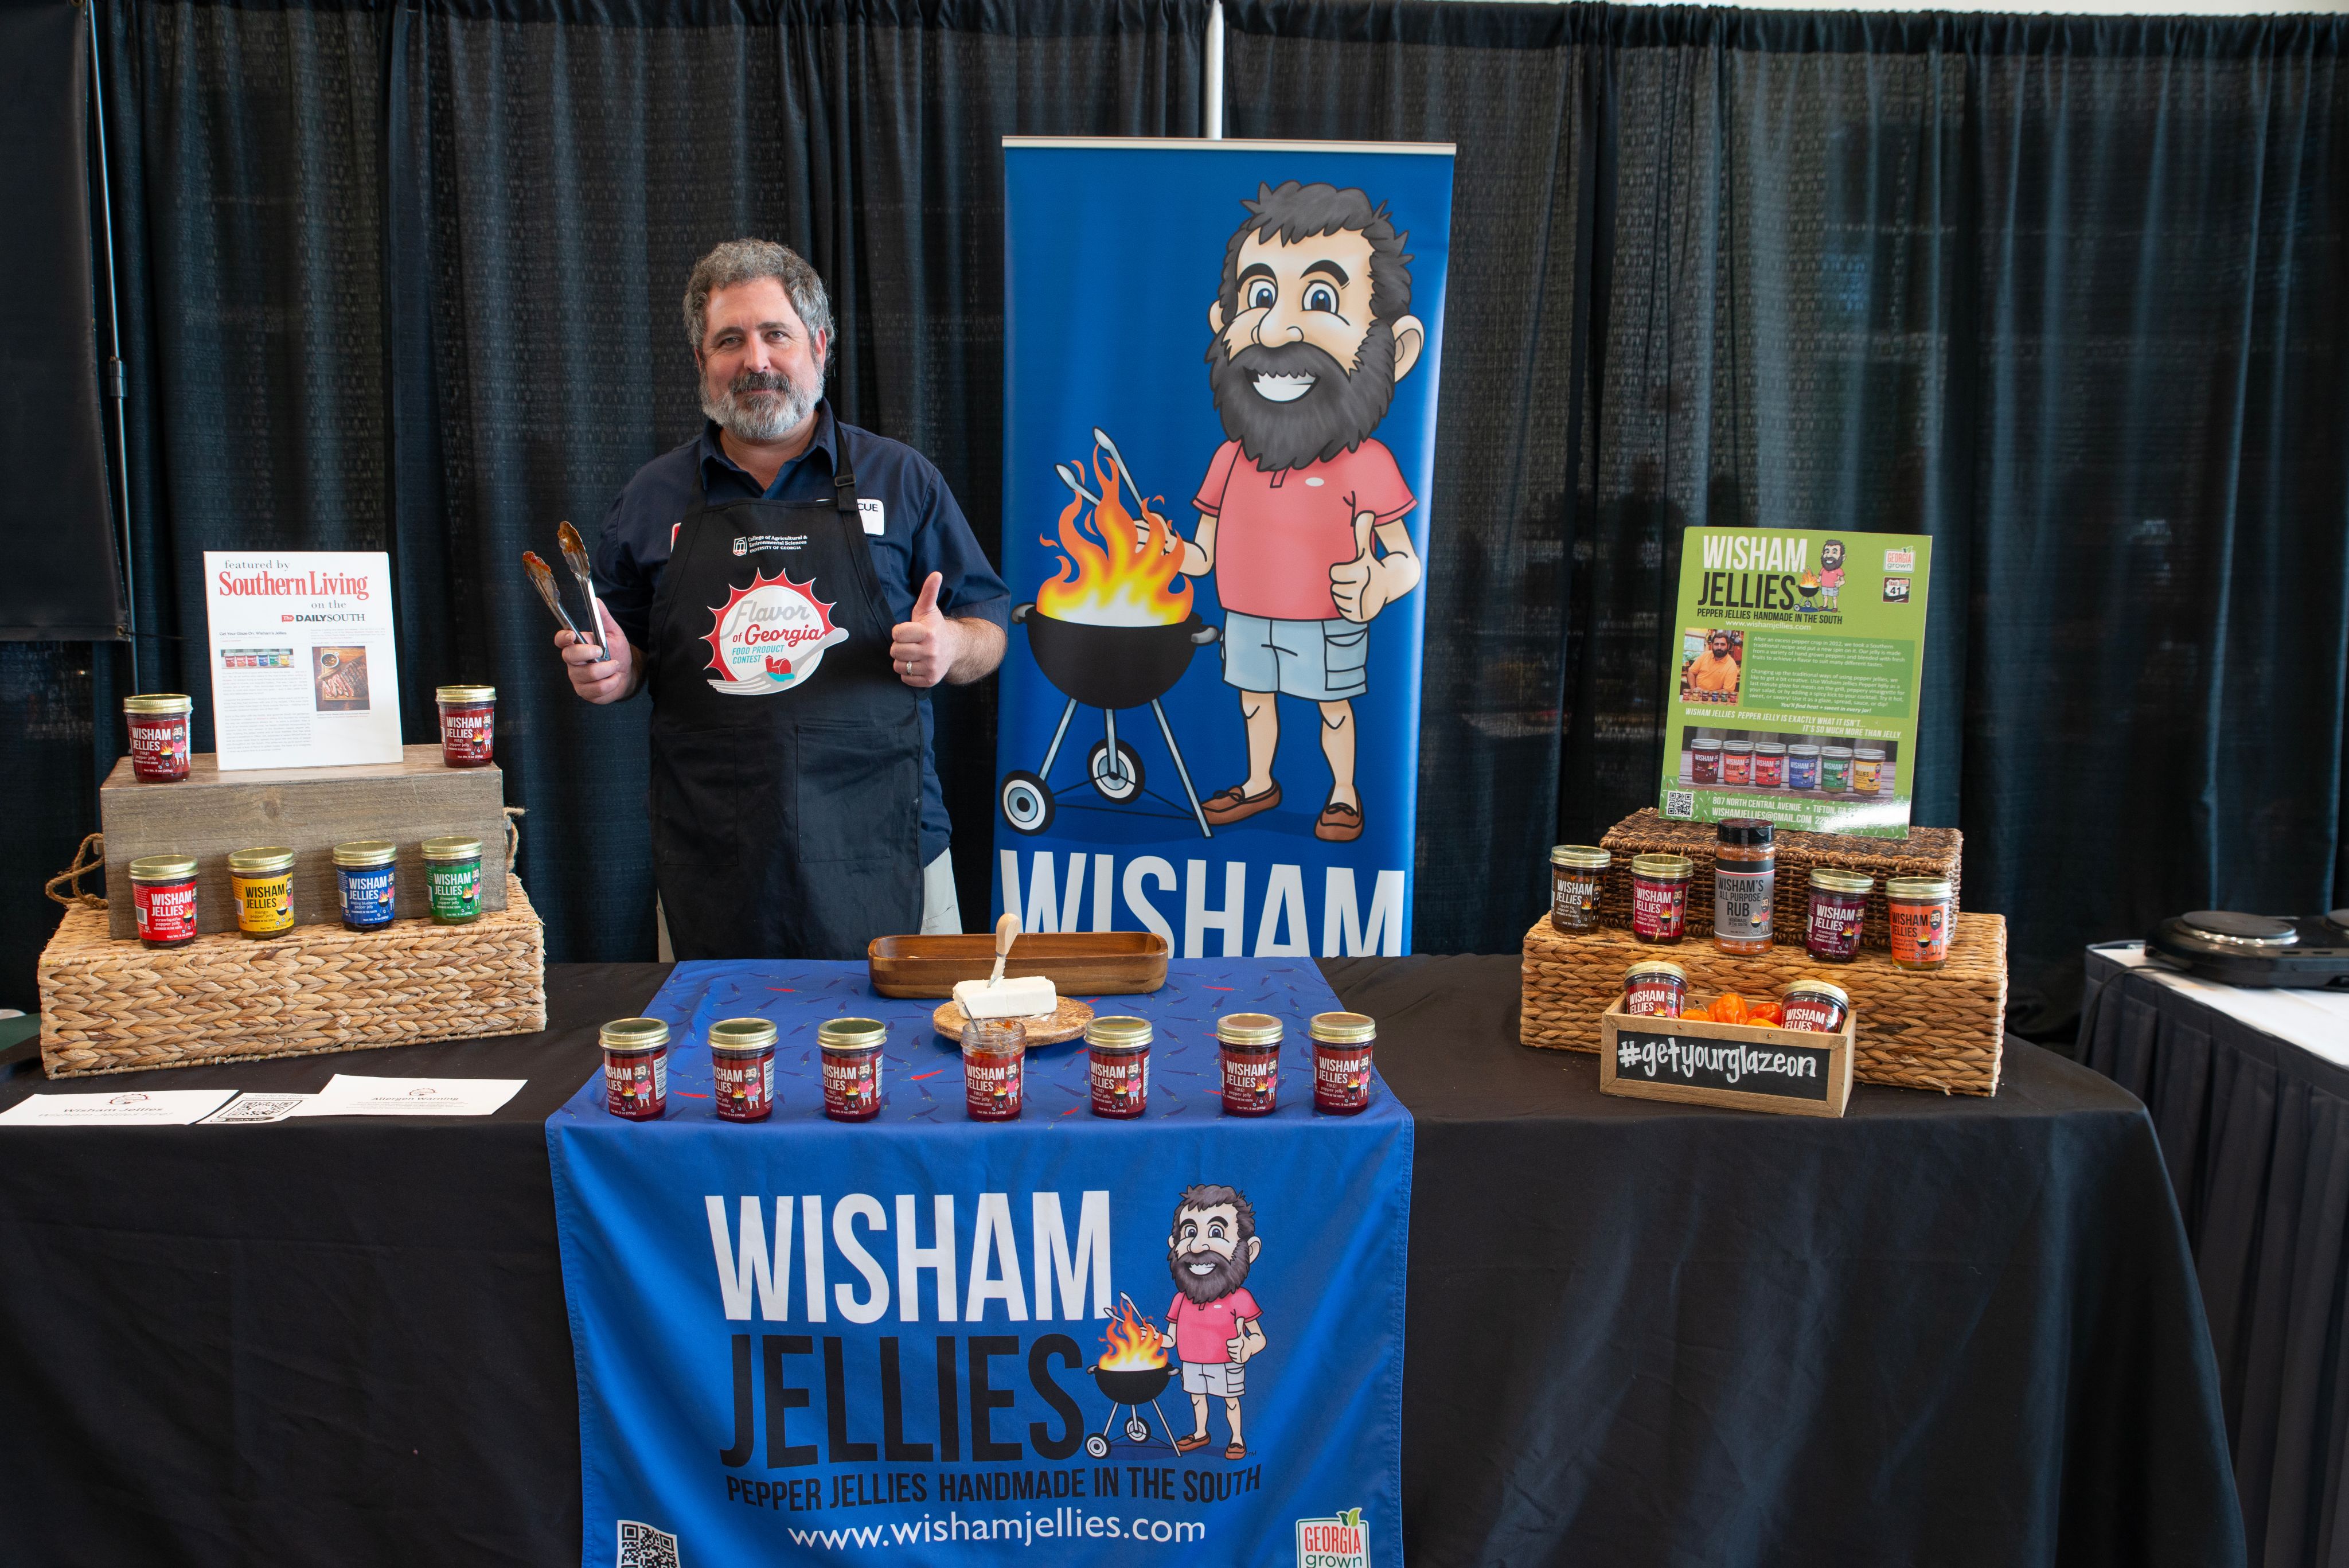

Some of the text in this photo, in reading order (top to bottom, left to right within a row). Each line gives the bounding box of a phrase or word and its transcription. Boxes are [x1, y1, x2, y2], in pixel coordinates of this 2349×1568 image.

[1703, 536, 1808, 573] WISHAM
[1888, 553, 1911, 563] GEORGIA
[225, 560, 290, 571] featured by
[219, 571, 369, 600] Southern Living
[1698, 572, 1796, 610] JELLIES
[1890, 587, 1901, 595] 41
[329, 600, 346, 609] the
[720, 600, 810, 639] Flavor
[1698, 609, 1842, 624] PEPPER JELLIES HANDMADE IN THE SOUTH
[1726, 620, 1811, 630] www.wishamjellies.com
[732, 624, 825, 647] of Georgia
[732, 645, 785, 656] FOOD PRODUCT
[732, 655, 762, 664] CONTEST
[446, 716, 482, 728] WISHAM
[1685, 708, 1711, 717] WISHAM
[1711, 710, 1735, 718] JELLIES
[1738, 712, 1762, 720] PEPPER
[1789, 715, 1816, 724] EXACTLY
[132, 727, 171, 740] WISHAM
[447, 728, 473, 738] JELLIES
[1825, 727, 1844, 735] MUCH
[1845, 728, 1863, 736] MORE
[134, 739, 160, 751] JELLIES
[1726, 798, 1747, 806] NORTH
[1749, 799, 1776, 809] CENTRAL
[1777, 802, 1801, 811] AVENUE
[1712, 807, 1811, 824] WISHAMJELLIES@GMAIL.COM
[349, 876, 387, 890] WISHAM
[434, 872, 471, 885] WISHAM
[1718, 876, 1763, 892] WISHAM'S
[245, 883, 284, 898] WISHAM
[435, 886, 462, 896] JELLIES
[1558, 879, 1592, 895] WISHAM
[151, 890, 192, 906] WISHAM
[349, 890, 379, 900] JELLIES
[1556, 891, 1582, 905] JELLIES
[1637, 888, 1671, 904] WISHAM
[1719, 891, 1761, 902] ALL PURPOSE
[151, 905, 184, 916] JELLIES
[246, 898, 276, 909] JELLIES
[1000, 849, 1404, 958] WISHAM
[1636, 900, 1660, 914] JELLIES
[1727, 902, 1749, 916] RUB
[1817, 904, 1855, 921] WISHAM
[1892, 912, 1927, 926] WISHAM
[1815, 917, 1844, 931] JELLIES
[1893, 927, 1917, 937] JELLIES
[1629, 990, 1664, 1005] WISHAM
[1786, 1009, 1825, 1024] WISHAM
[1319, 1056, 1359, 1072] WISHAM
[1617, 1037, 1817, 1084] #getyourglazeon
[822, 1062, 856, 1079] WISHAM
[967, 1064, 1004, 1080] WISHAM
[1090, 1060, 1125, 1078] WISHAM
[1227, 1060, 1266, 1076] WISHAM
[1091, 1073, 1114, 1089] JELLIES
[1227, 1074, 1255, 1087] JELLIES
[1319, 1070, 1348, 1083] JELLIES
[967, 1078, 993, 1091] JELLIES
[704, 1190, 1112, 1324] WISHAM
[719, 1333, 1084, 1469] JELLIES
[725, 1464, 1261, 1511] PEPPER JELLIES HANDMADE IN THE SOUTH
[787, 1507, 1206, 1550] www.wishamjellies.com
[1305, 1526, 1361, 1554] GEORGIA
[1305, 1554, 1362, 1568] grown
